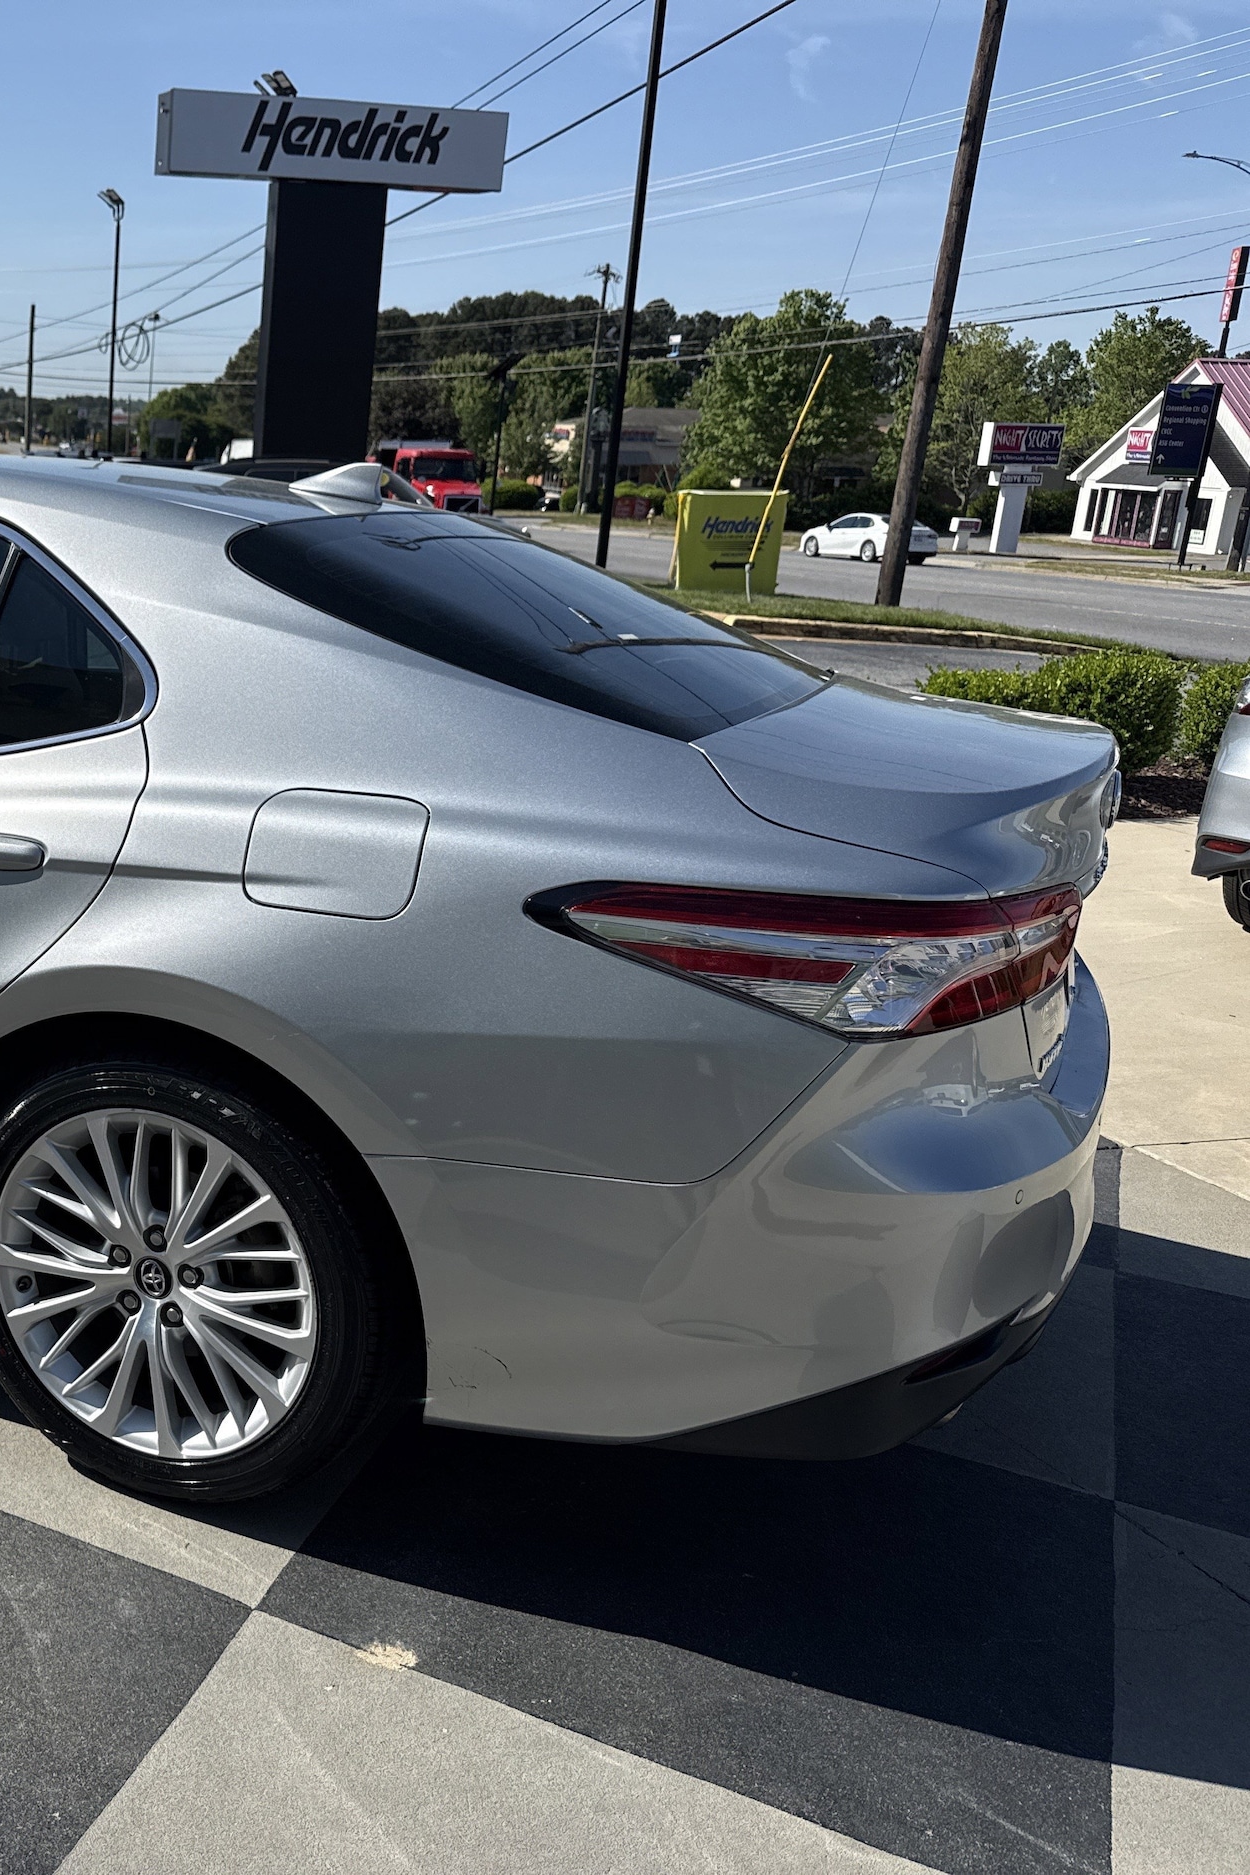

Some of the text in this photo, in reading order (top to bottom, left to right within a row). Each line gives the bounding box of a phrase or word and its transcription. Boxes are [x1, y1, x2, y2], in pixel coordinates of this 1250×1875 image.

[241, 99, 450, 171] Hendrick
[1028, 430, 1062, 448] SECRETS
[1000, 475, 1041, 483] DRIVE THRU
[701, 516, 774, 539] Hendrik
